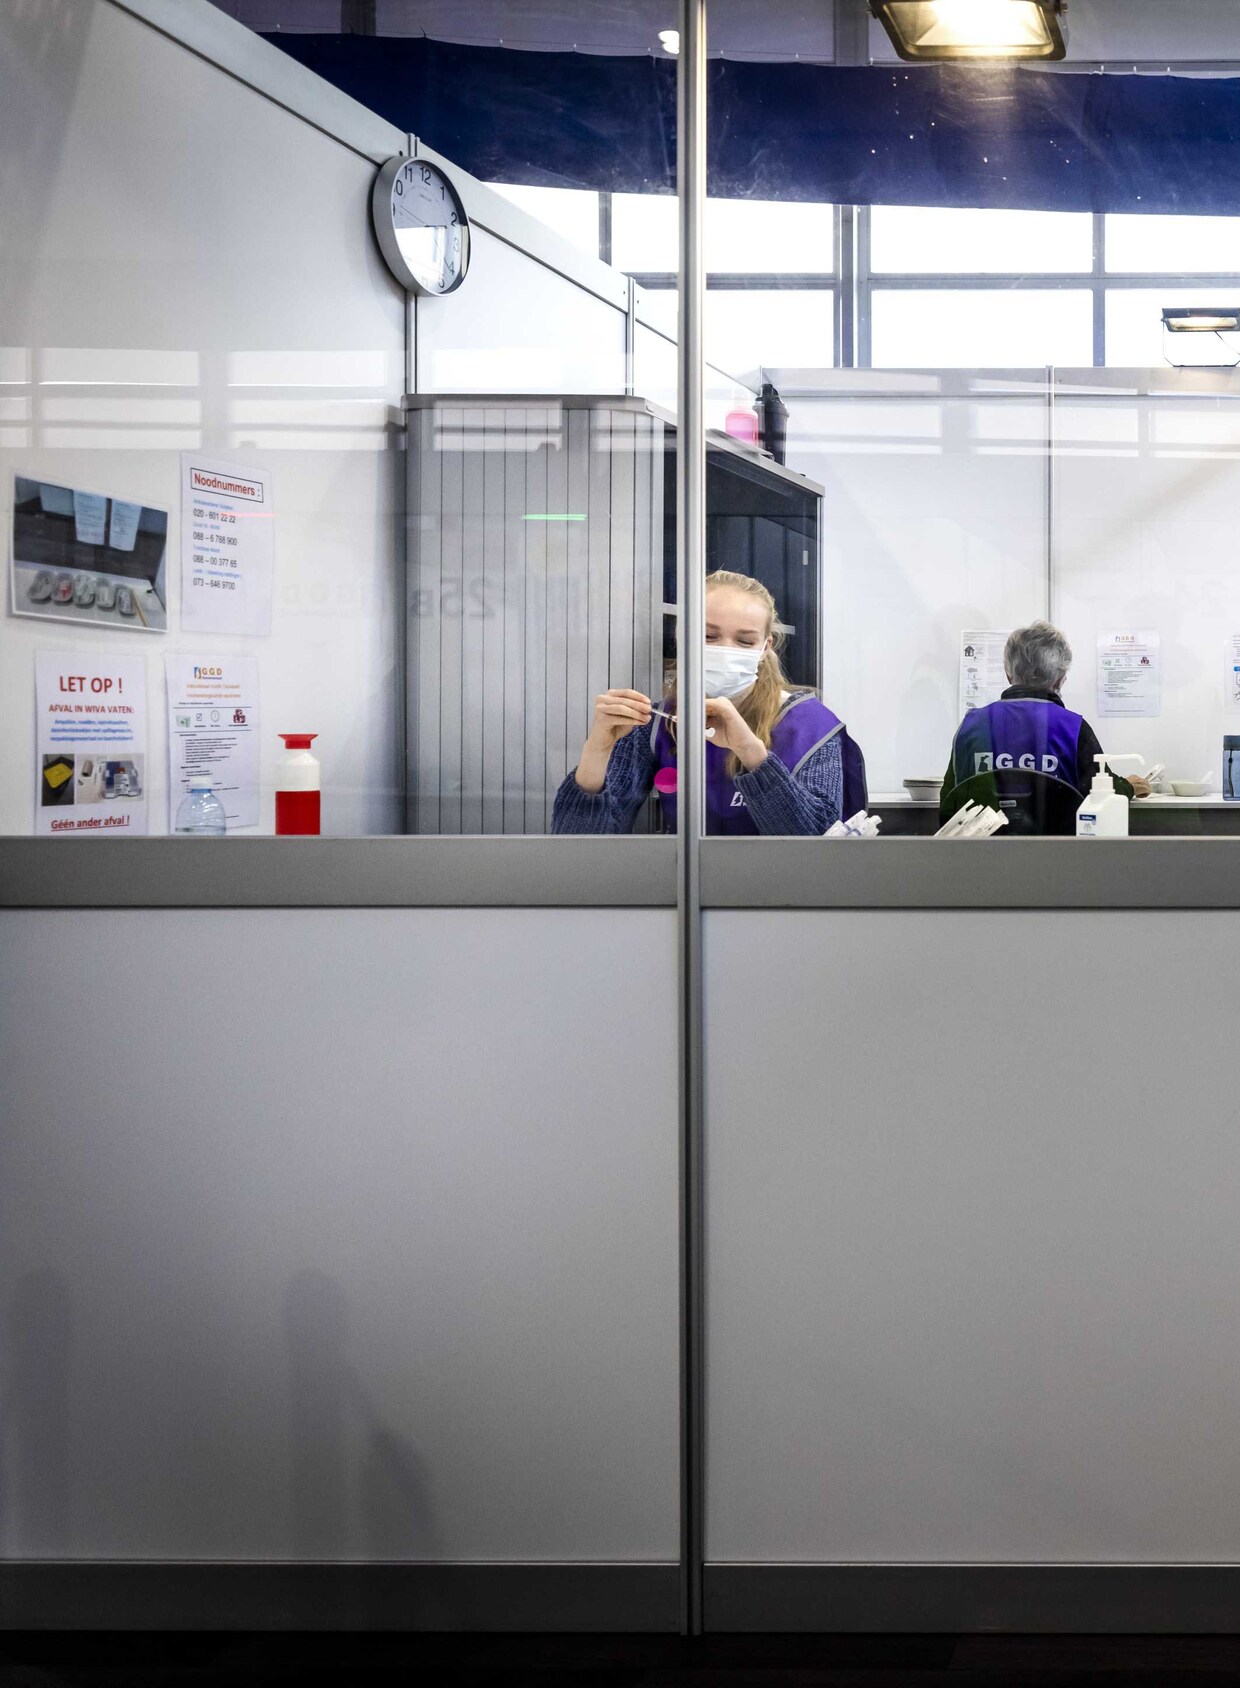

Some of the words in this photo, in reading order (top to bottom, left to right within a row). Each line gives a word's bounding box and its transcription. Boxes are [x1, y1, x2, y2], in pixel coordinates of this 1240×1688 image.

[404, 165, 413, 182] 11
[420, 167, 432, 186] 12
[394, 179, 403, 196] 0
[440, 186, 445, 200] 1
[451, 212, 458, 227] 2
[194, 472, 255, 496] Noodnummers
[193, 508, 204, 518] 020
[220, 512, 228, 522] 22
[229, 513, 236, 523] 22
[227, 536, 237, 546] 900
[59, 676, 86, 692] LET
[91, 677, 112, 693] OP
[119, 678, 122, 694] !
[48, 704, 73, 713] AFVAL
[75, 705, 83, 713] IN
[84, 705, 106, 713] WIVA
[996, 753, 1059, 772] GGD
[51, 817, 74, 829] Géén
[77, 817, 102, 827] ander
[104, 816, 124, 825] afval
